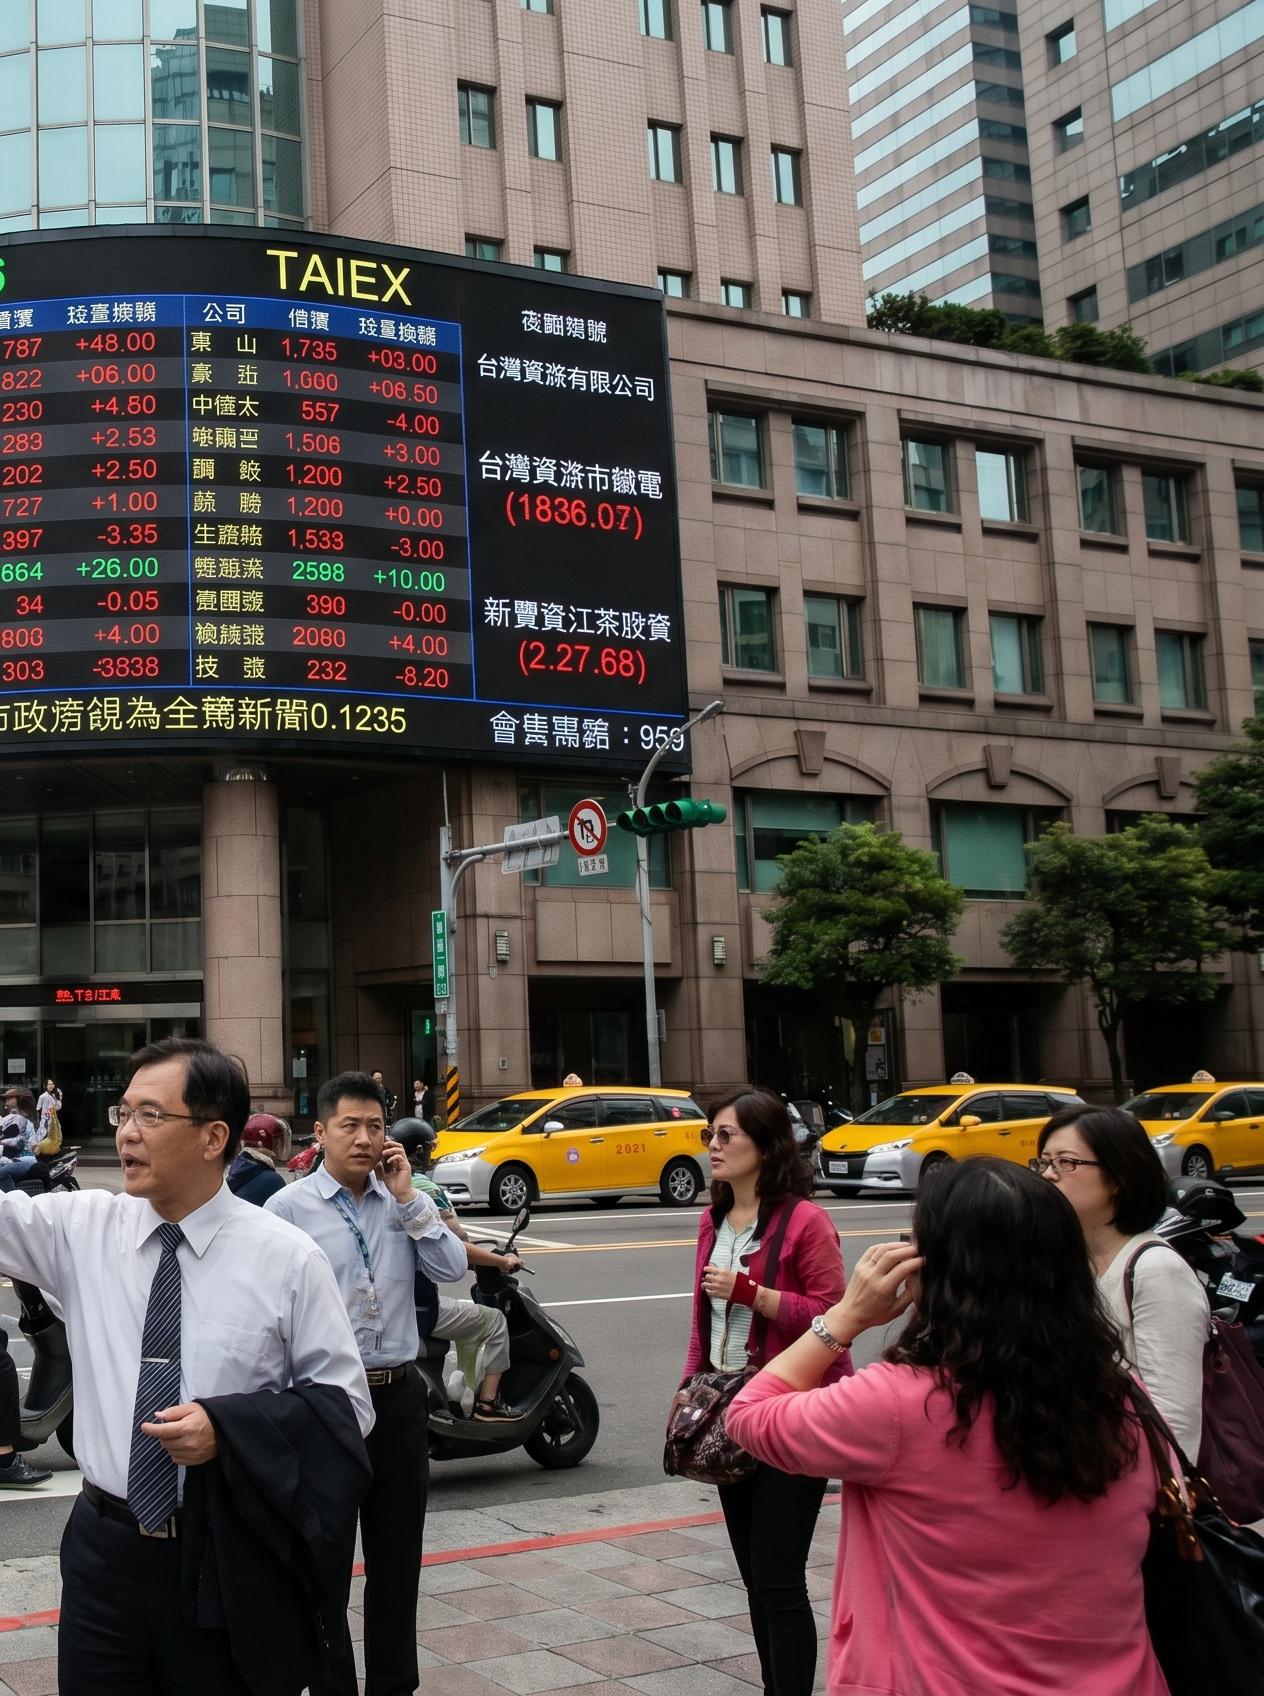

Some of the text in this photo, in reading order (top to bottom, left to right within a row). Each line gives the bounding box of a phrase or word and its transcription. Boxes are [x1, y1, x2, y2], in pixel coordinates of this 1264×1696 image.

[267, 250, 411, 305] TAIEX
[203, 303, 245, 324] 公司
[76, 332, 155, 352] +48.00
[237, 336, 256, 354] 山
[369, 350, 436, 373] +03.00
[77, 364, 155, 384] +06.00
[370, 380, 437, 404] +06.50
[303, 401, 439, 434] 557 -4.00
[92, 427, 156, 447] +2.53
[384, 443, 439, 465] +3.00
[92, 459, 156, 479] +2.50
[385, 475, 441, 496] +2.50
[93, 492, 157, 511] +1.00
[386, 506, 442, 528] +0.00
[98, 524, 157, 544] -3.35
[393, 538, 443, 559] -3.00
[77, 556, 159, 579] +26.00
[292, 560, 446, 592] 2598 +10.00
[17, 591, 158, 615] 34 -0.05
[307, 595, 446, 623] 390 -0.00
[96, 624, 159, 644] +4.00
[293, 626, 447, 656] 2080 +4.00
[3, 660, 44, 681] 303
[520, 641, 645, 684] (2.27.68)
[308, 660, 448, 688] 232 -8.20
[616, 1144, 645, 1154] 2021
